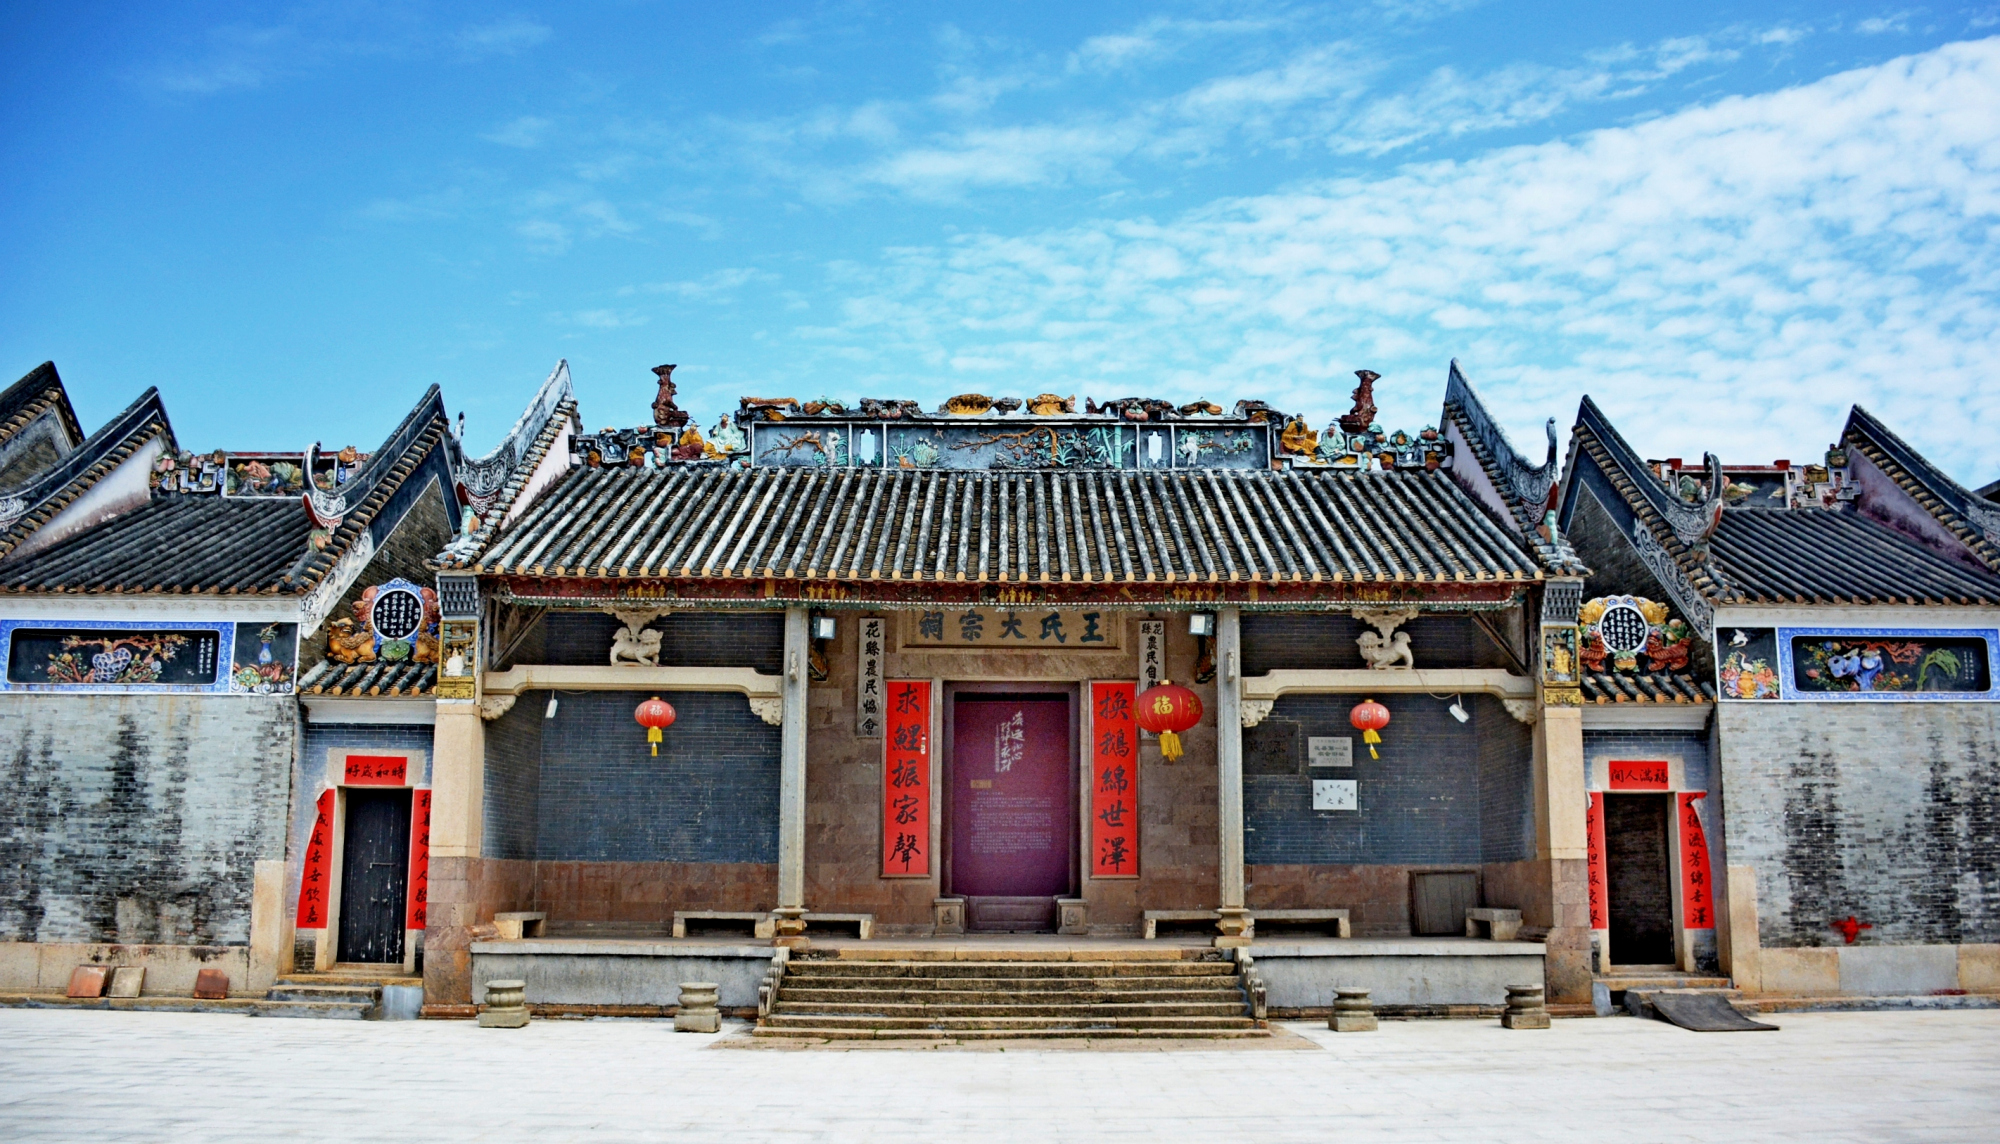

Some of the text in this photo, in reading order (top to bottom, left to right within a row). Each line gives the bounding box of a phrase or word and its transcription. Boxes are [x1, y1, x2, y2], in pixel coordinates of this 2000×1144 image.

[919, 609, 1104, 643] 王氏大宗祠
[649, 704, 663, 716] 福
[1152, 695, 1174, 715] 福
[889, 684, 922, 873] 求鯉振家聲
[1098, 690, 1131, 873] 換鵝綿世澤
[1611, 768, 1668, 784] 福滿人間
